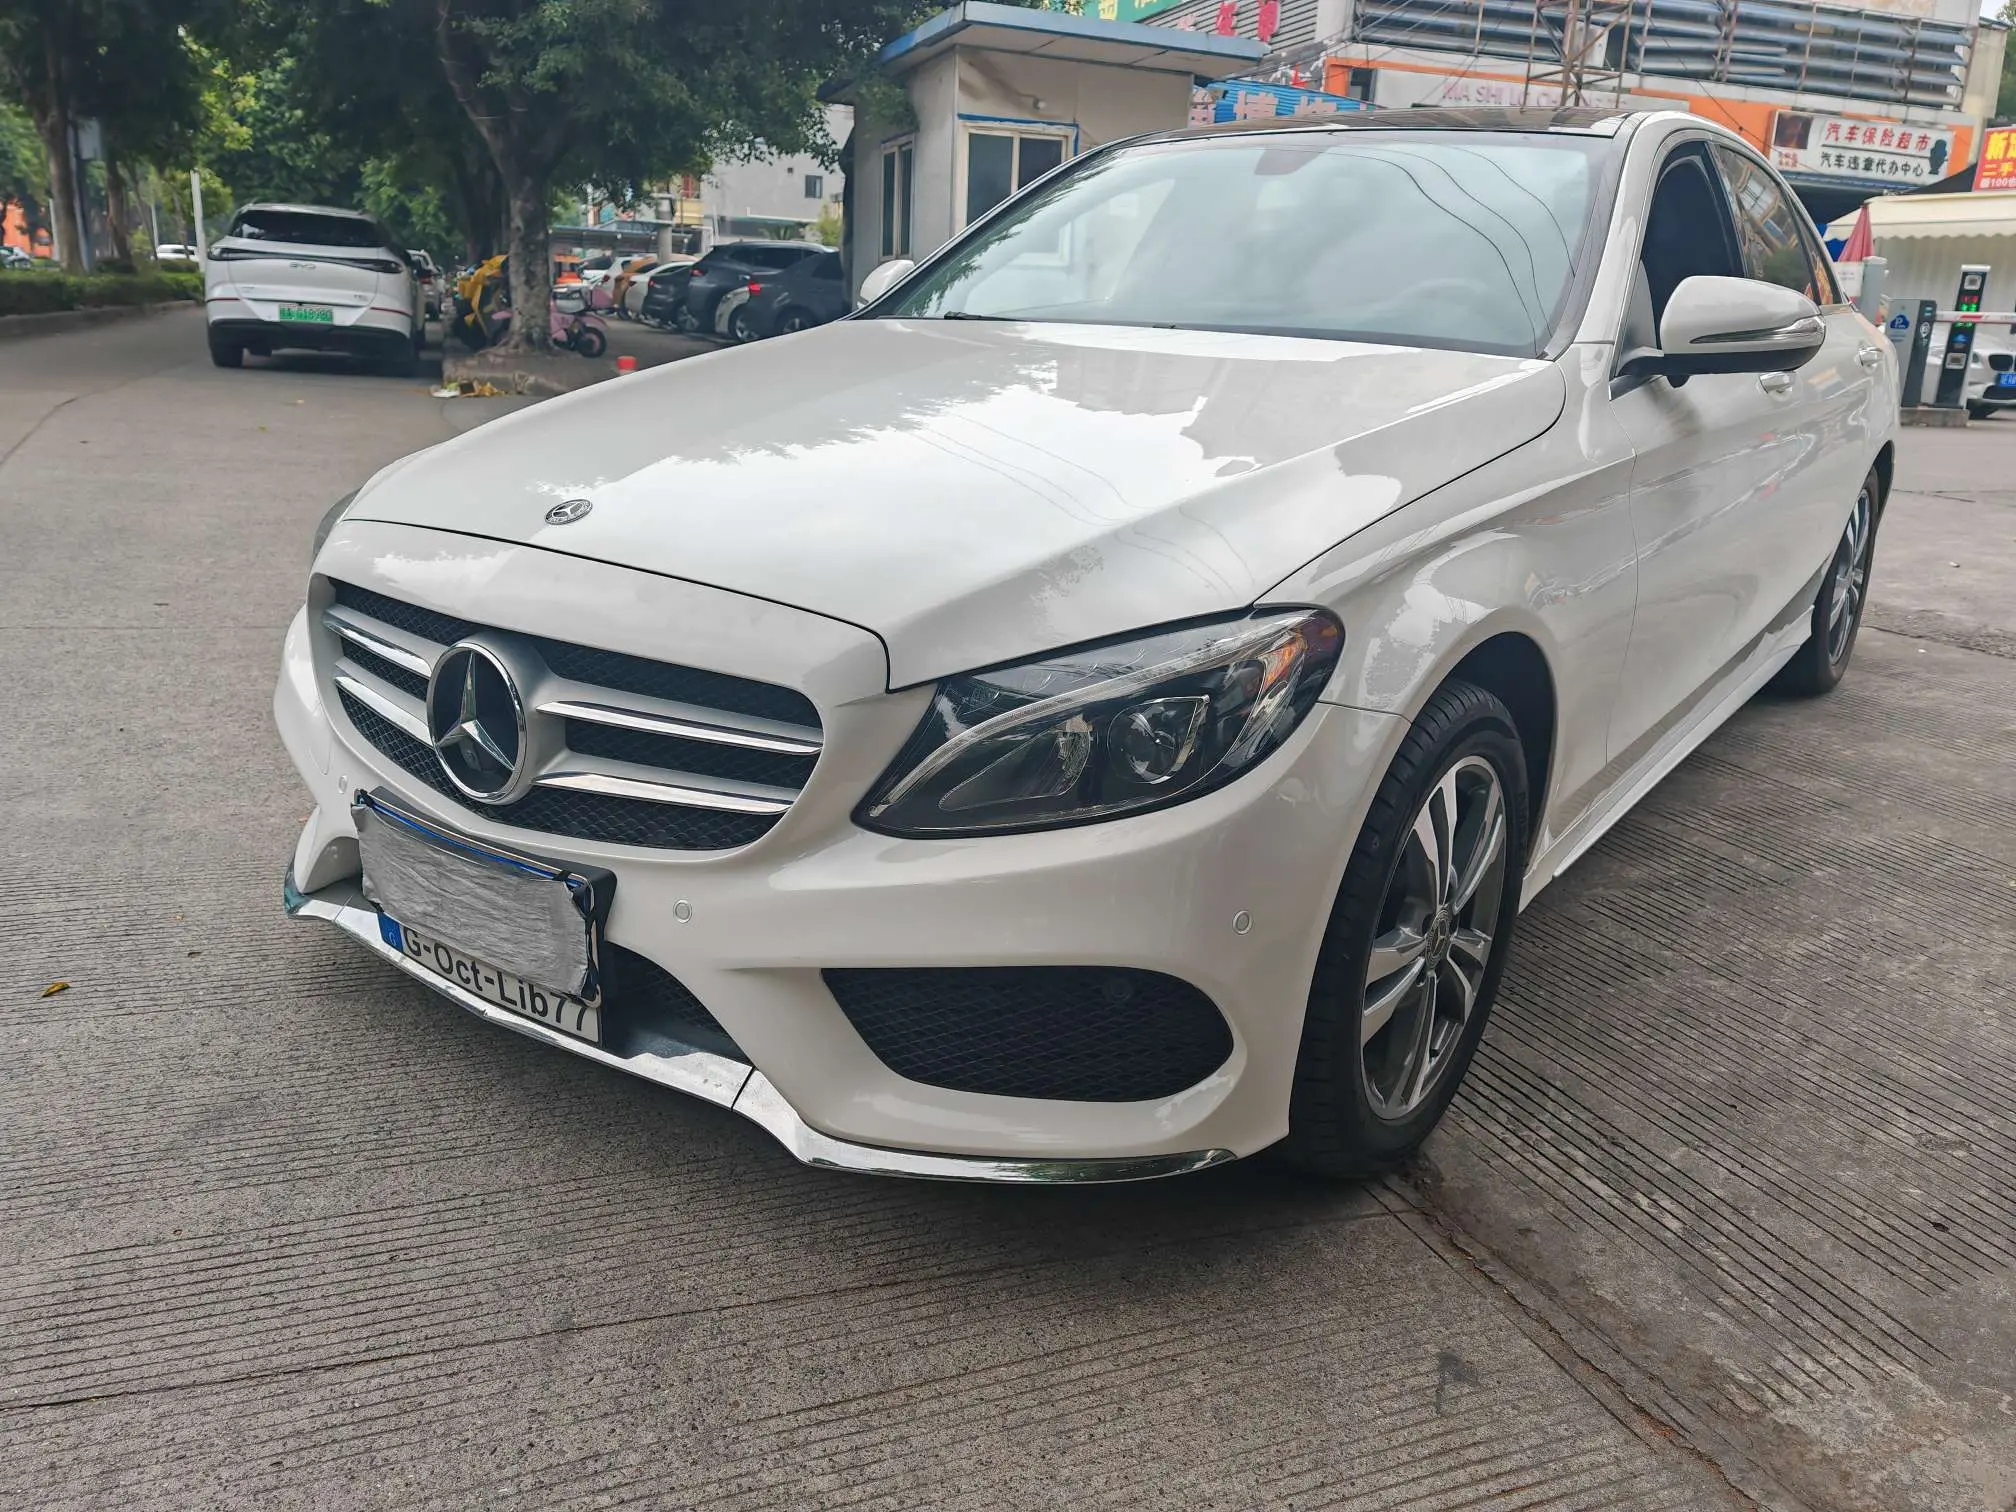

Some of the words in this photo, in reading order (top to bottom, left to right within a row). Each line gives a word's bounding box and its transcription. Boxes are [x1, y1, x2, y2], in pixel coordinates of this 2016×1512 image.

[1825, 122, 1931, 152] 汽车保险超市
[1820, 152, 1924, 177] 汽车违章代办中心
